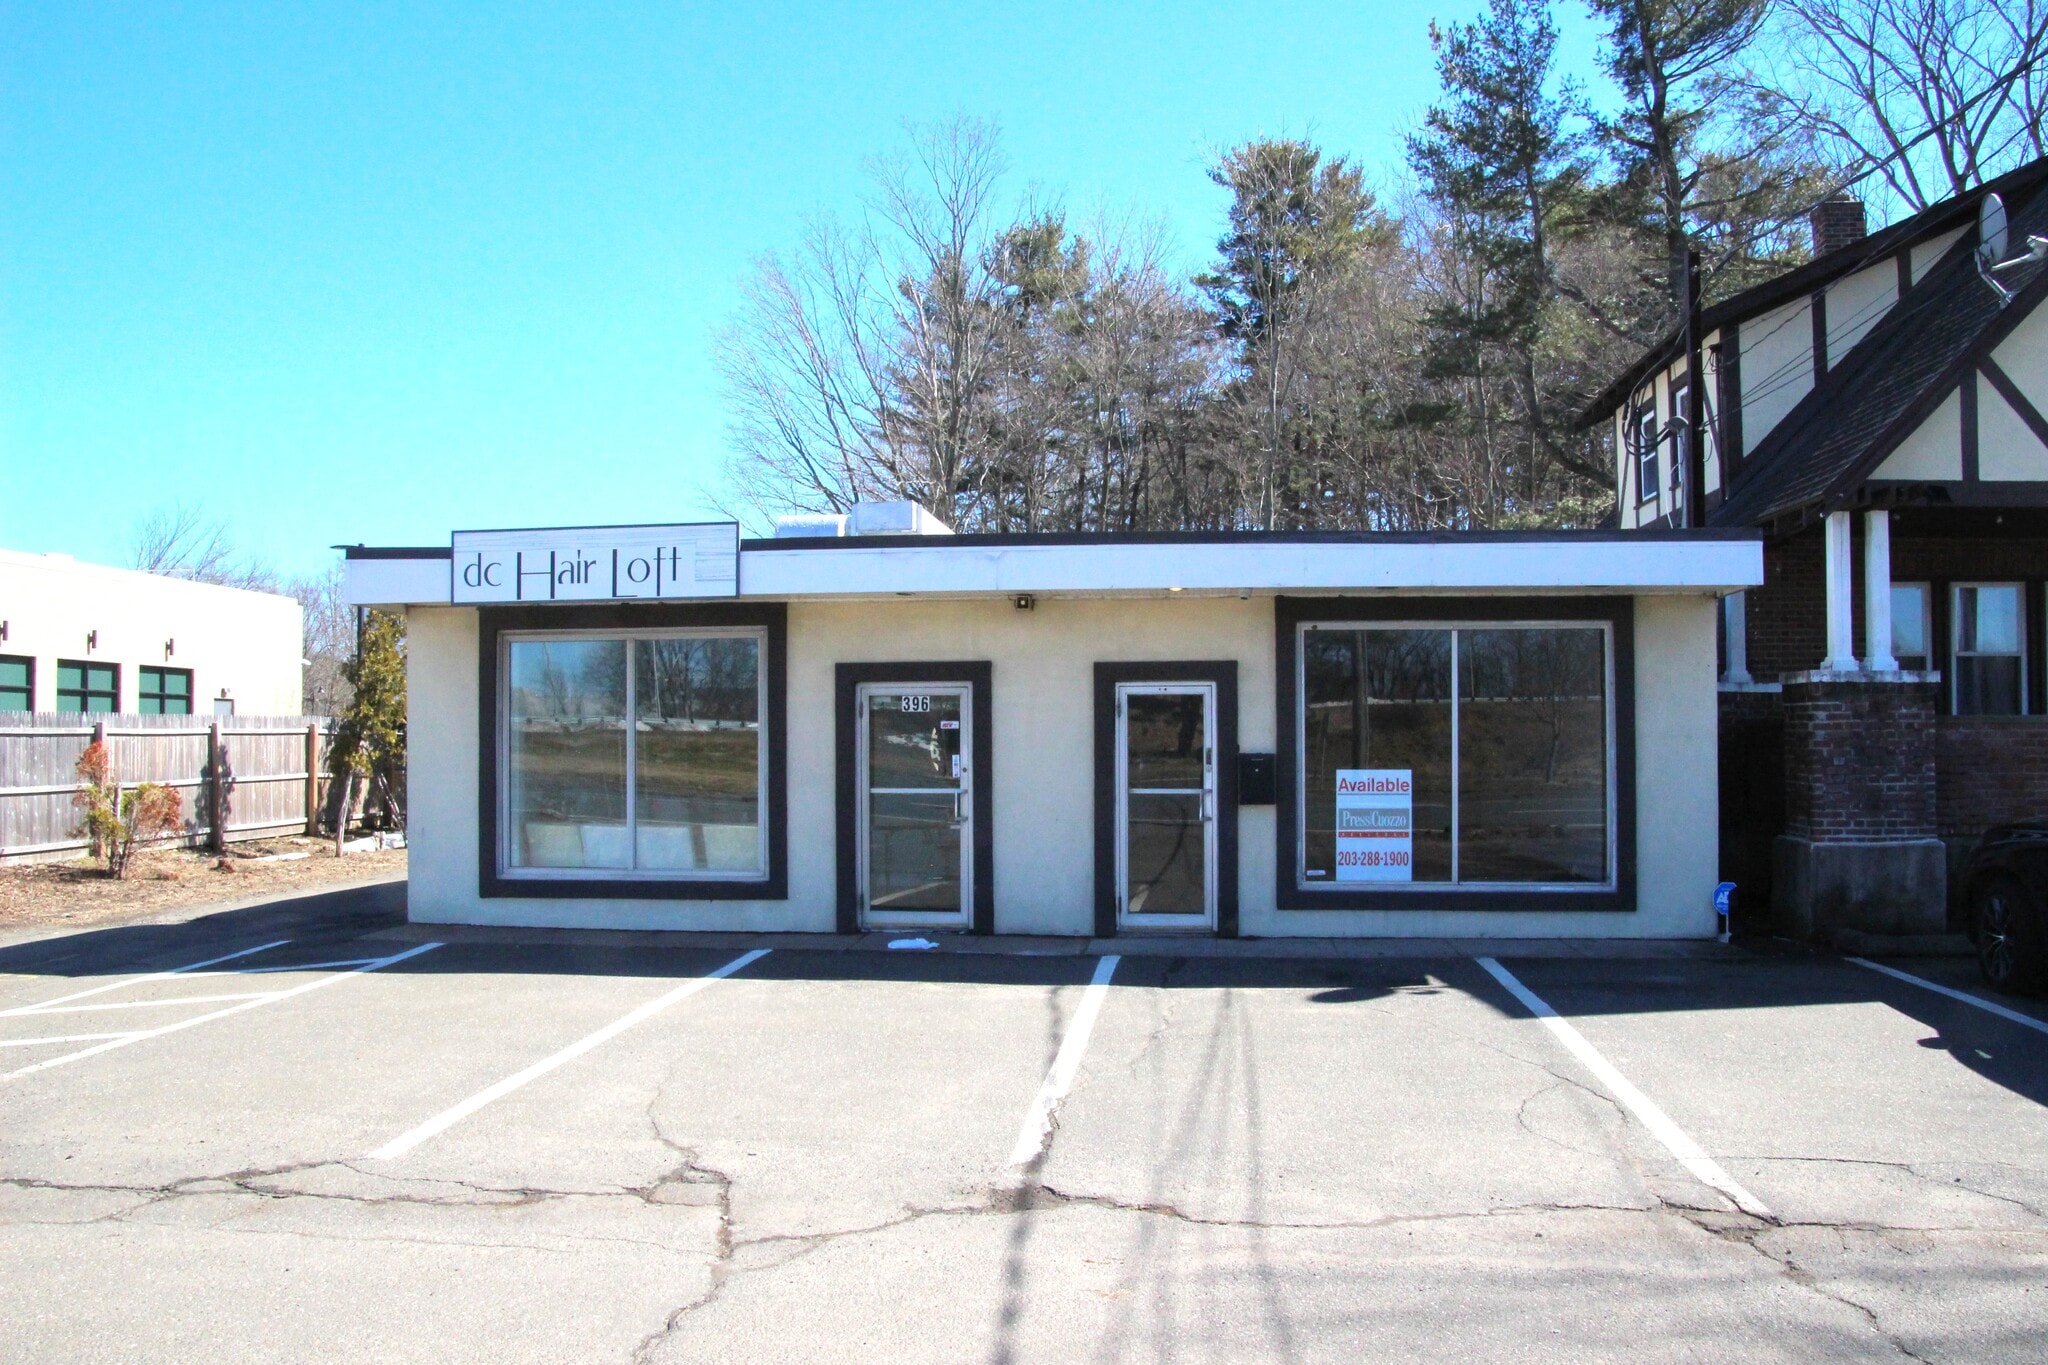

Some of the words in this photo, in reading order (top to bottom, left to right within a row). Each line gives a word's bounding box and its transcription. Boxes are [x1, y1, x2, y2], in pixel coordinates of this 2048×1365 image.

[463, 552, 502, 587] dc
[517, 550, 597, 600] Hair
[612, 546, 682, 598] Loft
[904, 697, 928, 711] 396
[1338, 777, 1410, 792] Available
